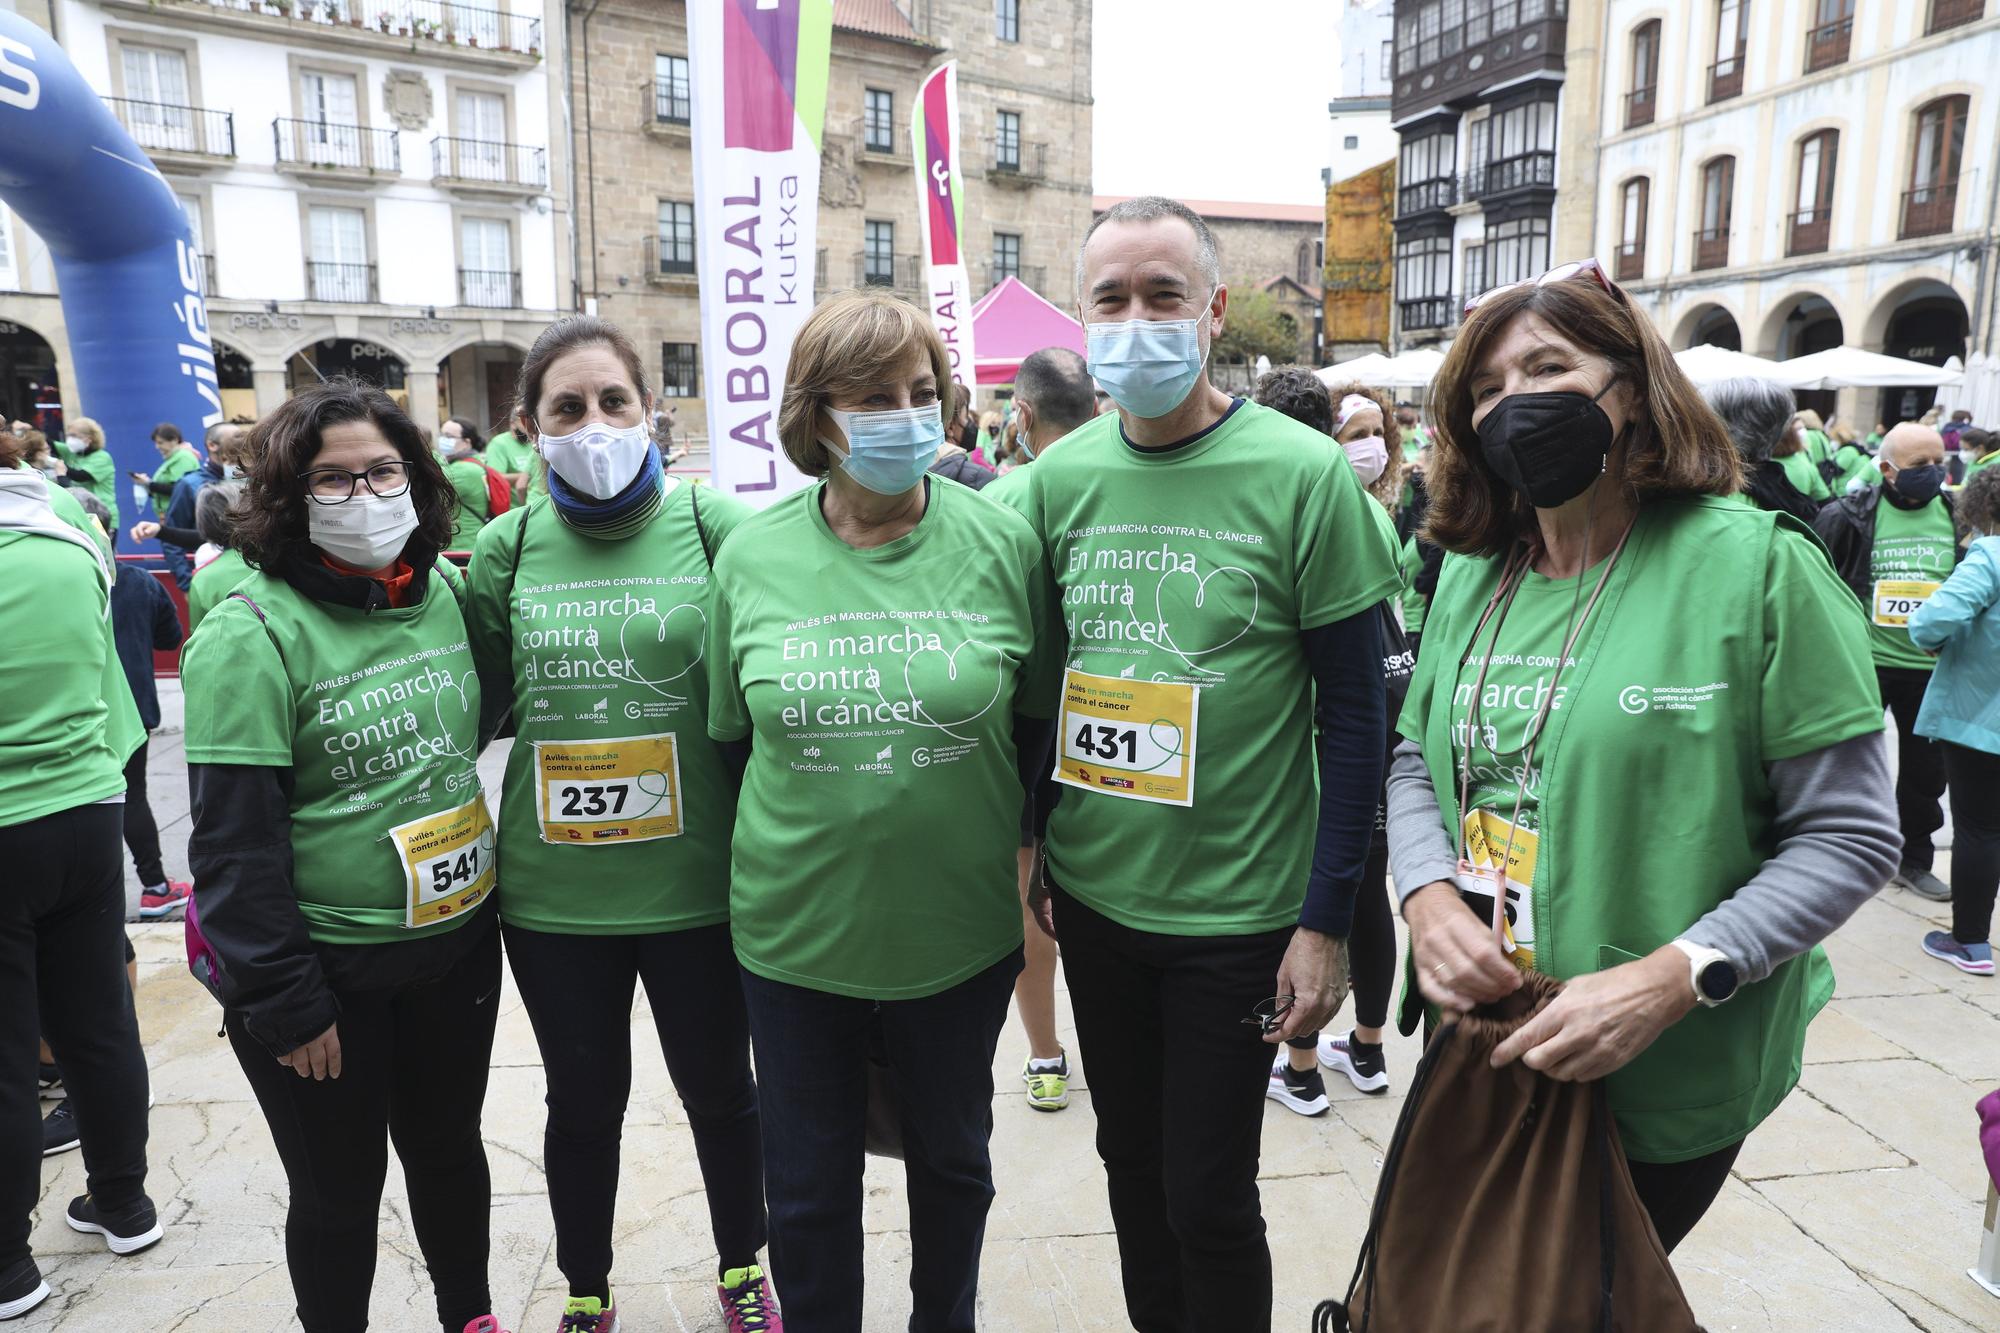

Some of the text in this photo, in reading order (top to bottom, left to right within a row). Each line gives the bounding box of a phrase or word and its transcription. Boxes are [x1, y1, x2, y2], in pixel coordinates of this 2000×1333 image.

[774, 176, 798, 304] kutxa
[723, 176, 777, 493] LABORAL
[1067, 524, 1263, 545] AVILÉS EN MARCHA CONTRA EL CÁNCER
[1069, 543, 1196, 573] En marcha
[1883, 544, 1934, 557] marcha
[521, 585, 553, 594] AVILÉS
[555, 583, 568, 591] EN
[570, 579, 611, 589] MARCHA
[613, 577, 654, 586] CONTRA
[656, 577, 668, 585] EL
[1065, 580, 1134, 605] contra
[519, 592, 656, 621] En marcha
[785, 609, 989, 632] AVILÉS EN MARCHA CONTRA EL CÁNCER
[1081, 613, 1169, 642] cáncer
[521, 624, 599, 650] contra
[783, 626, 941, 660] En marcha
[315, 675, 351, 692] AVILÉS
[352, 671, 364, 682] EN
[364, 657, 408, 677] MARCHA
[408, 649, 441, 664] CONTRA
[440, 647, 450, 656] EL
[525, 653, 635, 681] el cáncer
[780, 665, 881, 692] contra
[319, 666, 453, 726] En marcha
[1069, 682, 1134, 700] Avilés en marcha
[1652, 694, 1714, 702] contra el cáncer
[1695, 682, 1729, 693] española
[782, 697, 923, 727] el cáncer
[1067, 694, 1131, 711] contra el cáncer
[324, 709, 418, 755] contra
[786, 732, 820, 740] ASOCIACIÓN
[820, 731, 850, 739] ESPAÑOLA
[850, 730, 874, 738] CONTRA
[881, 728, 905, 737] CÁNCER
[1075, 723, 1137, 763] 431
[330, 733, 452, 780] el cáncer
[545, 753, 570, 762] Avilés
[584, 752, 619, 761] marcha
[803, 746, 820, 759] edp
[574, 763, 582, 771] el
[584, 762, 616, 771] cáncer
[791, 761, 840, 773] fundación
[854, 763, 893, 771] LABORAL
[398, 791, 431, 805] LABORAL
[561, 785, 629, 816] 237
[408, 816, 472, 843] Avilés en marcha
[411, 826, 472, 854] contra el cáncer
[1488, 846, 1520, 866] cáner
[432, 846, 478, 893] 541
